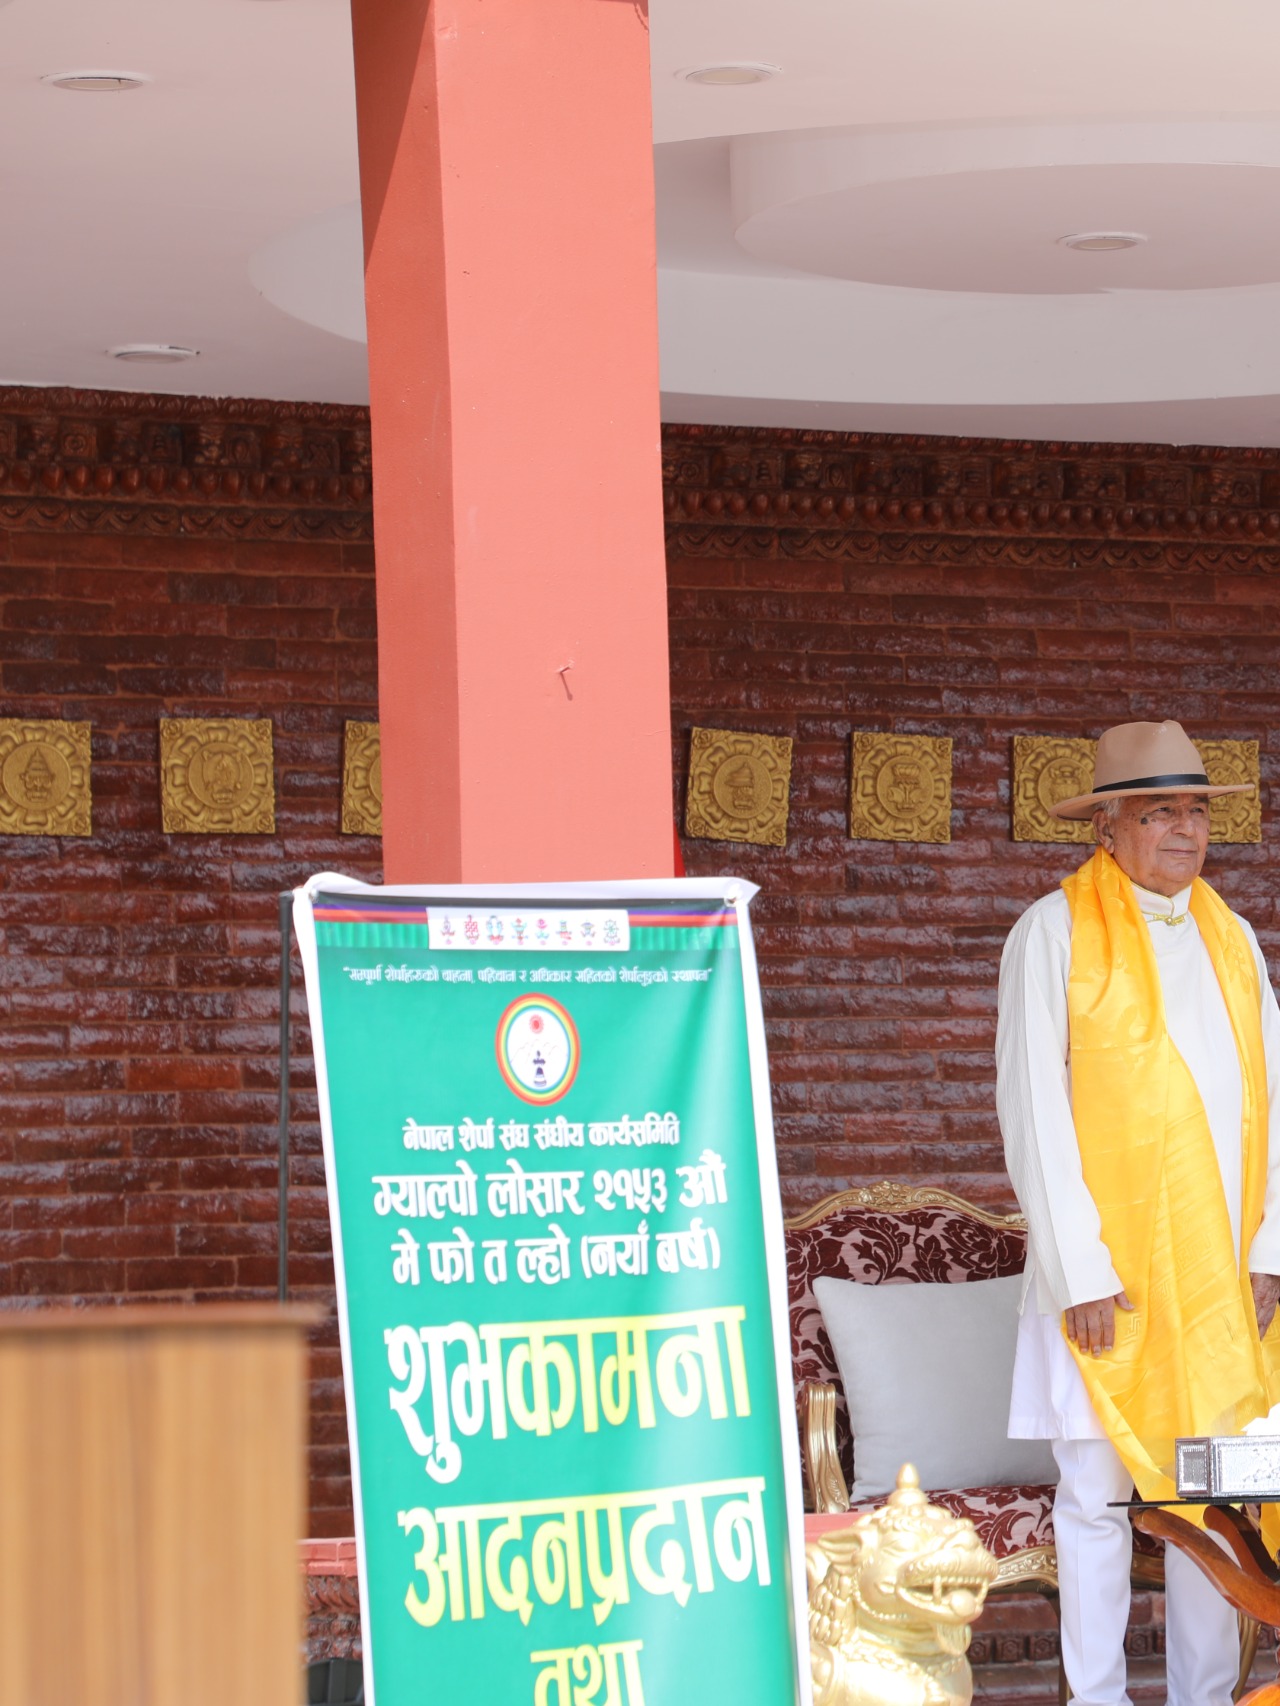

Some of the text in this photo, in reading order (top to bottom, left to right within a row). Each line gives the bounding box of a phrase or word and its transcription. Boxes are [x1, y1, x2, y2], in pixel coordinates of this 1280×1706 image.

[519, 969, 527, 982] र
[530, 967, 572, 982] अधिकार
[575, 966, 616, 983] सहितको
[402, 1111, 680, 1152] नेपाल शेर्पा संघ संघीय कार्यसमिति
[371, 1160, 478, 1219] ग्याल्पो
[485, 1158, 585, 1218] लोसार
[593, 1167, 667, 1214] २१५३
[391, 1229, 421, 1286] मे
[428, 1226, 475, 1284] फो
[482, 1239, 508, 1284] त
[514, 1223, 570, 1285] ल्हो
[580, 1219, 650, 1279] (नयाँ
[383, 1305, 752, 1485] शुभकामना
[396, 1476, 772, 1628] आदनप्रदान
[530, 1640, 645, 1706] तथा
